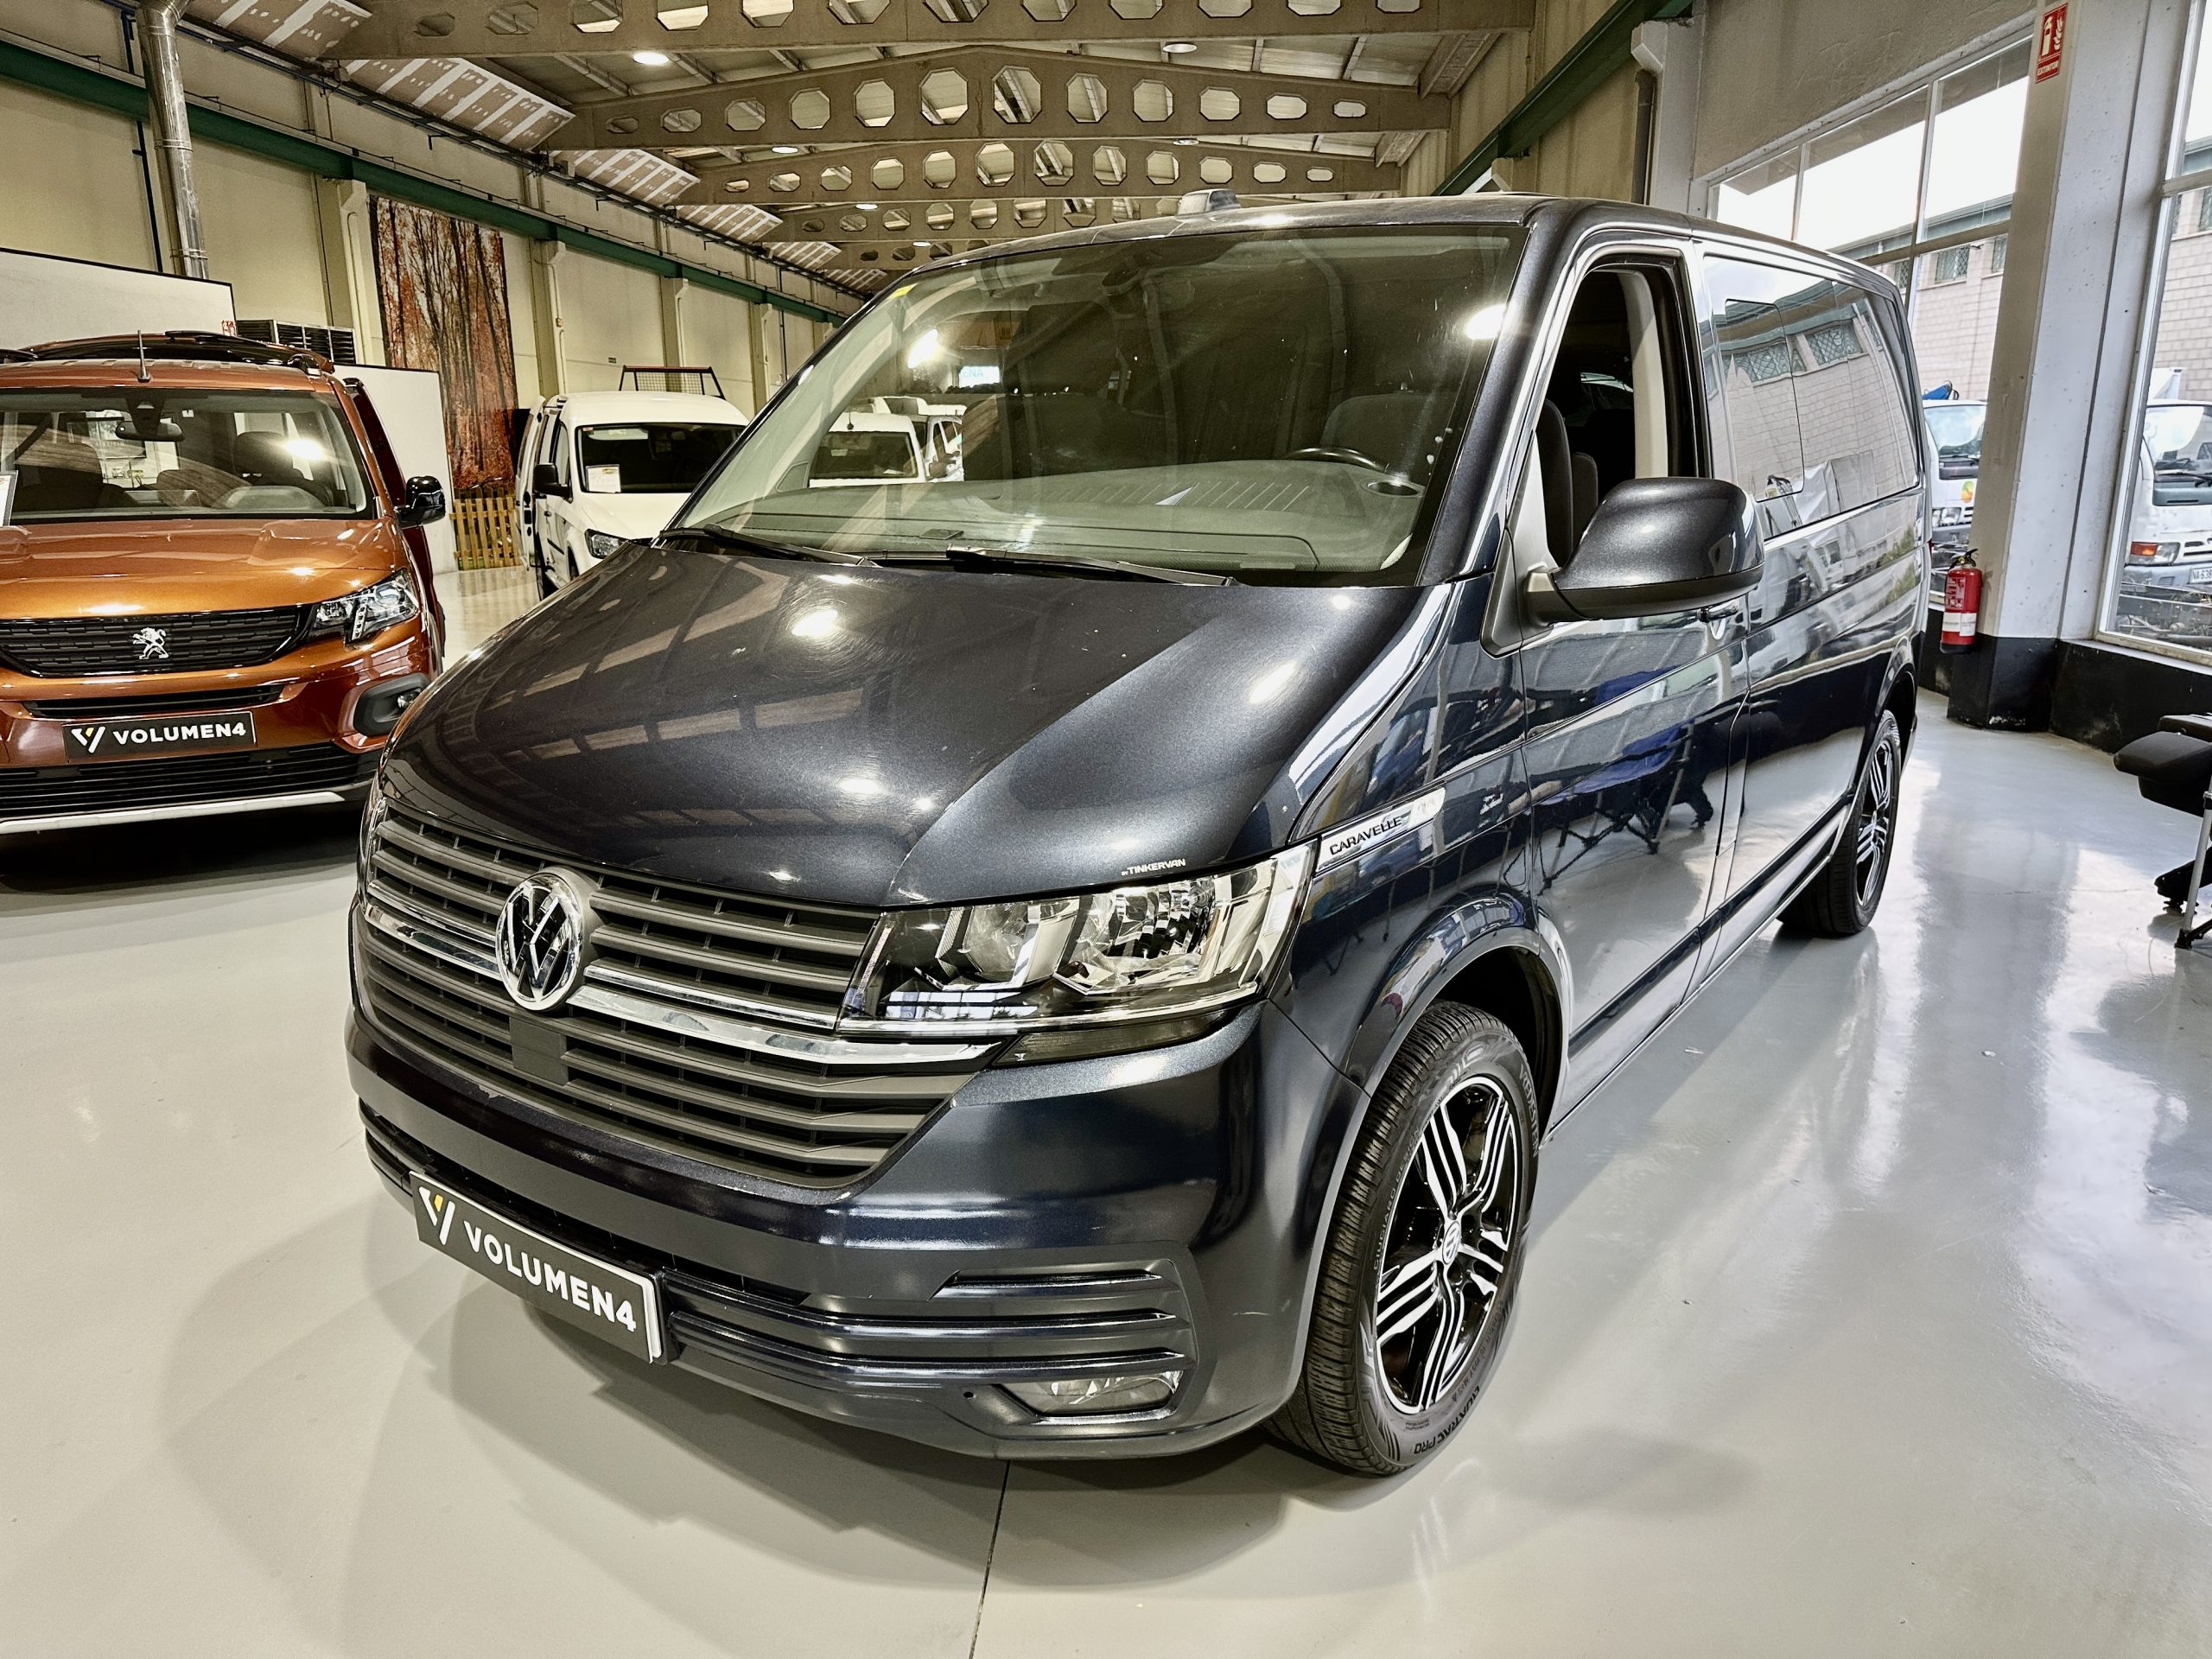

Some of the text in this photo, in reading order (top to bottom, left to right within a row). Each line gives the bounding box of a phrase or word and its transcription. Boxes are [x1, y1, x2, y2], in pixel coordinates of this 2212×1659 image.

[112, 721, 247, 746] VOLUMEN4
[1329, 817, 1402, 855] CARAVELLE
[1127, 858, 1186, 875] TINKERVAN
[463, 1219, 637, 1332] VOLUMEN4
[1414, 1435, 1436, 1454] PRO
